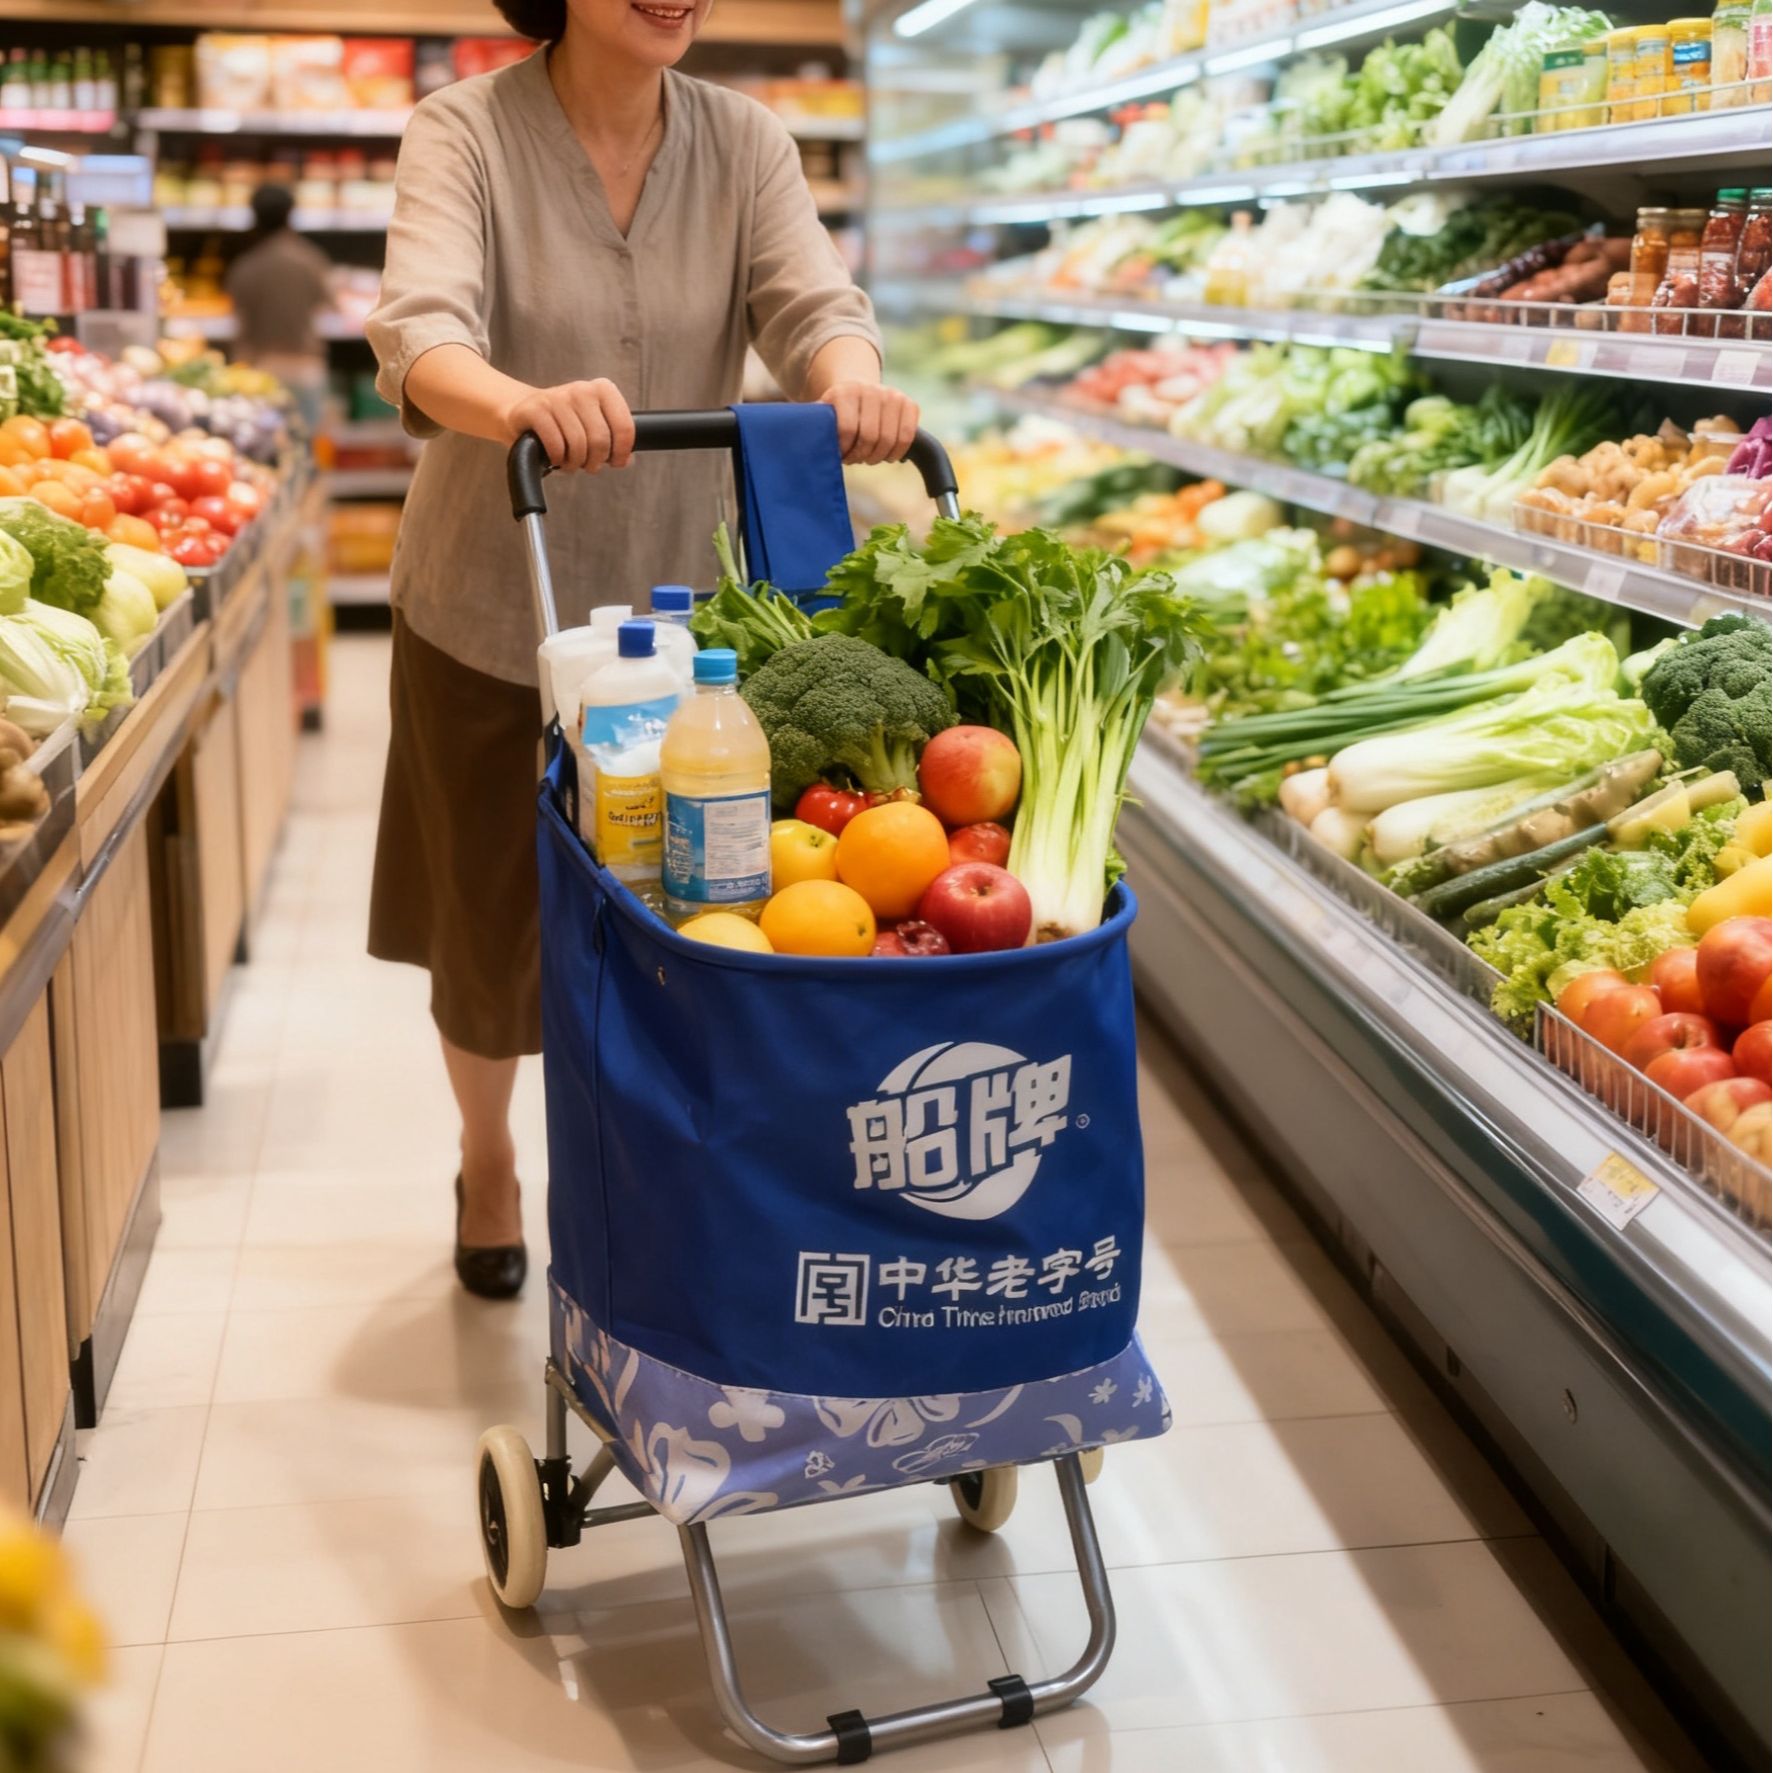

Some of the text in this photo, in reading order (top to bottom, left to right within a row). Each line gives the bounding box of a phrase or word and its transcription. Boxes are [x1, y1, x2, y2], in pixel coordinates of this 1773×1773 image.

[846, 1054, 1073, 1191] 船牌
[878, 1235, 1121, 1301] 中华老字号
